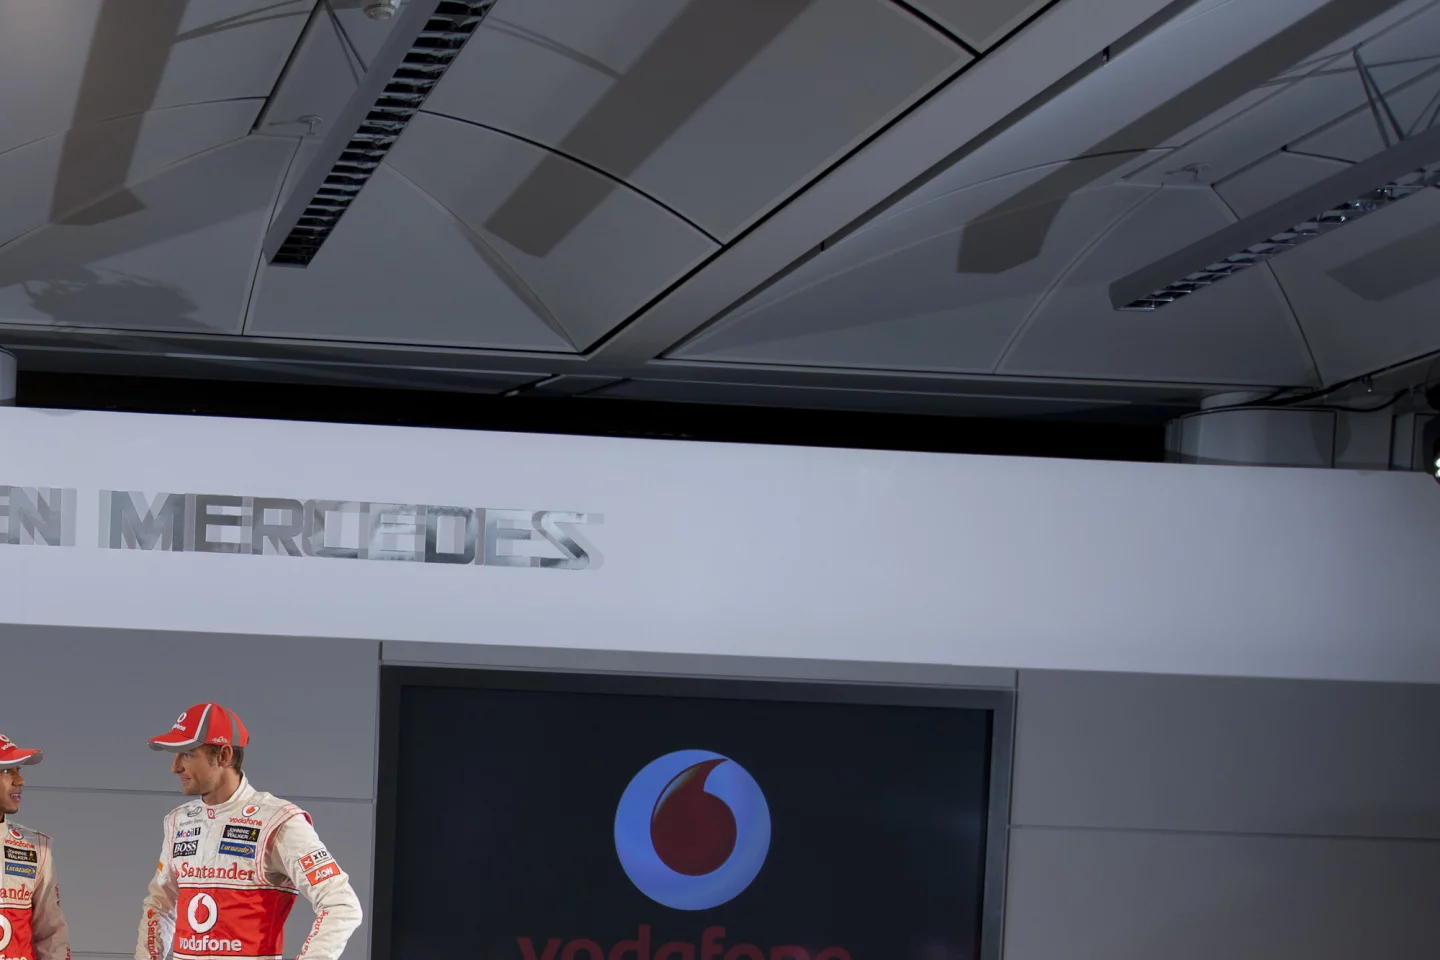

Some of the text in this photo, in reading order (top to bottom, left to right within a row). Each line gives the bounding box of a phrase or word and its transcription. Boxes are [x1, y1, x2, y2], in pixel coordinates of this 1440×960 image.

[109, 490, 592, 570] MERCEDES
[229, 817, 262, 826] vodafone
[176, 829, 194, 839] Mobil
[4, 839, 35, 849] vodafone
[174, 841, 197, 853] BOSS
[181, 861, 256, 881] Santander
[179, 935, 242, 952] vodafone
